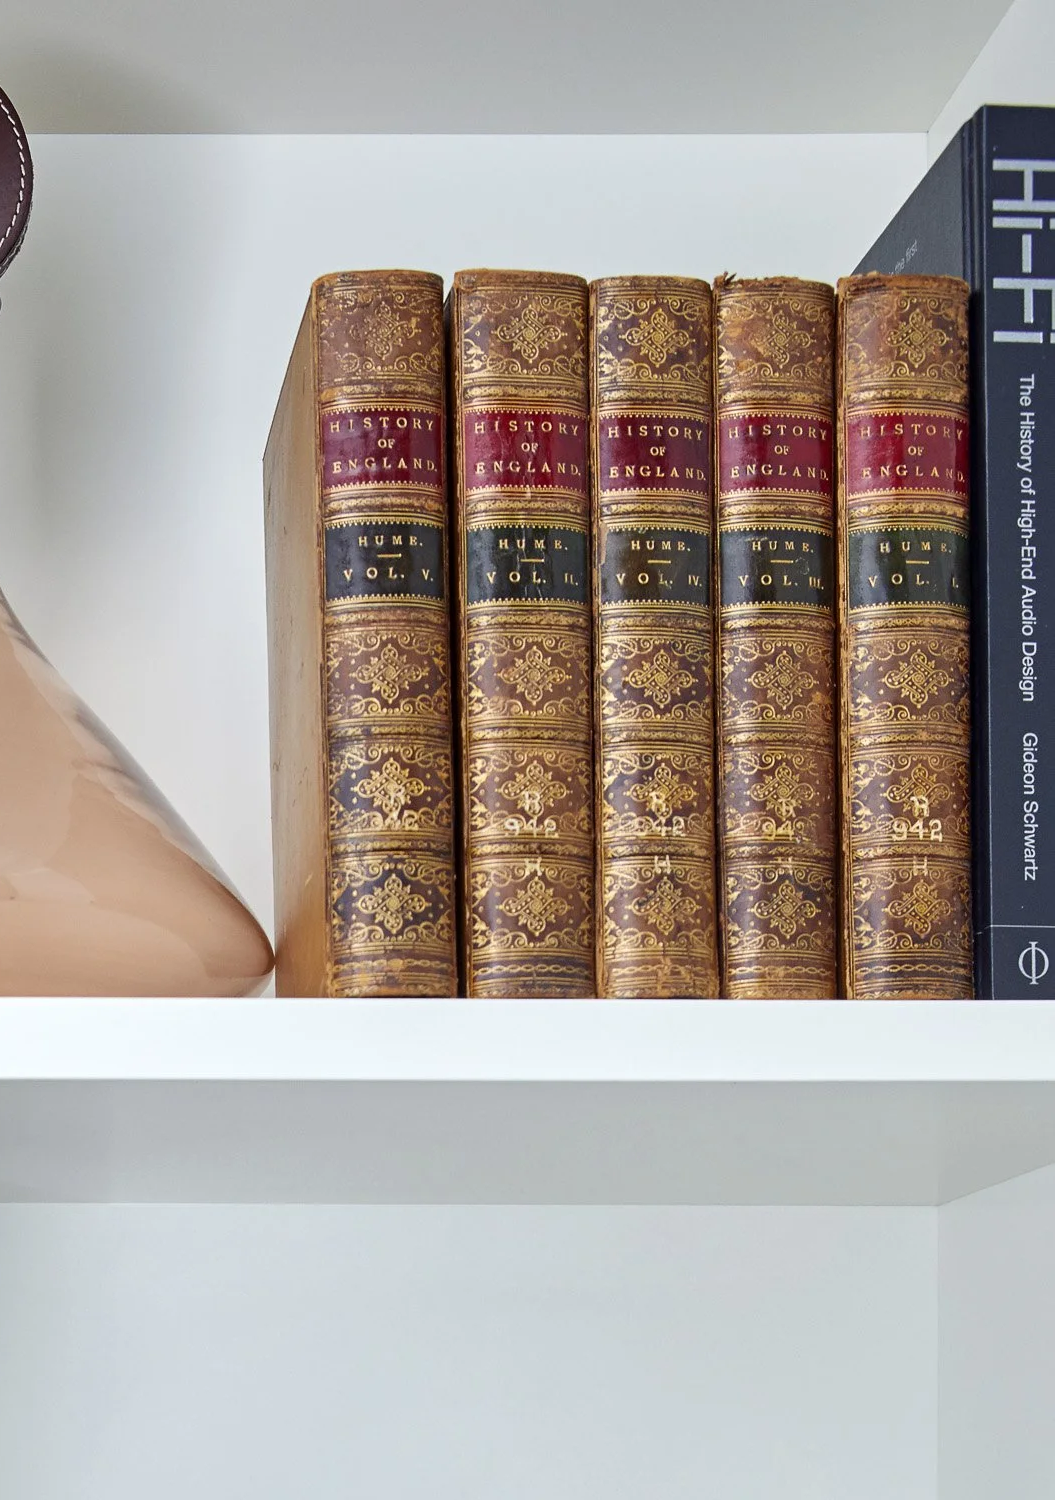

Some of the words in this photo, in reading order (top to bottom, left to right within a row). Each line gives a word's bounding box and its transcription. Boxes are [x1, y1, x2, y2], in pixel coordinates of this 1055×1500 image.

[992, 159, 1055, 343] Hi-Fi
[1019, 373, 1035, 407] The
[330, 417, 434, 433] HISTORY
[474, 420, 579, 437] HISTORY
[608, 425, 703, 441] HISTORY
[728, 424, 827, 441] HISTORY
[860, 423, 964, 442] HISTORY
[377, 438, 396, 449] OF
[650, 446, 666, 457] OF
[774, 445, 789, 455] OF
[907, 446, 925, 456] OF
[1017, 412, 1035, 473] History
[1020, 476, 1036, 495] of
[1017, 499, 1036, 580] High-End
[1021, 585, 1037, 637] Audio
[1018, 642, 1038, 702] Design
[1022, 732, 1038, 795] Gideon
[1023, 800, 1039, 881] Schwartz
